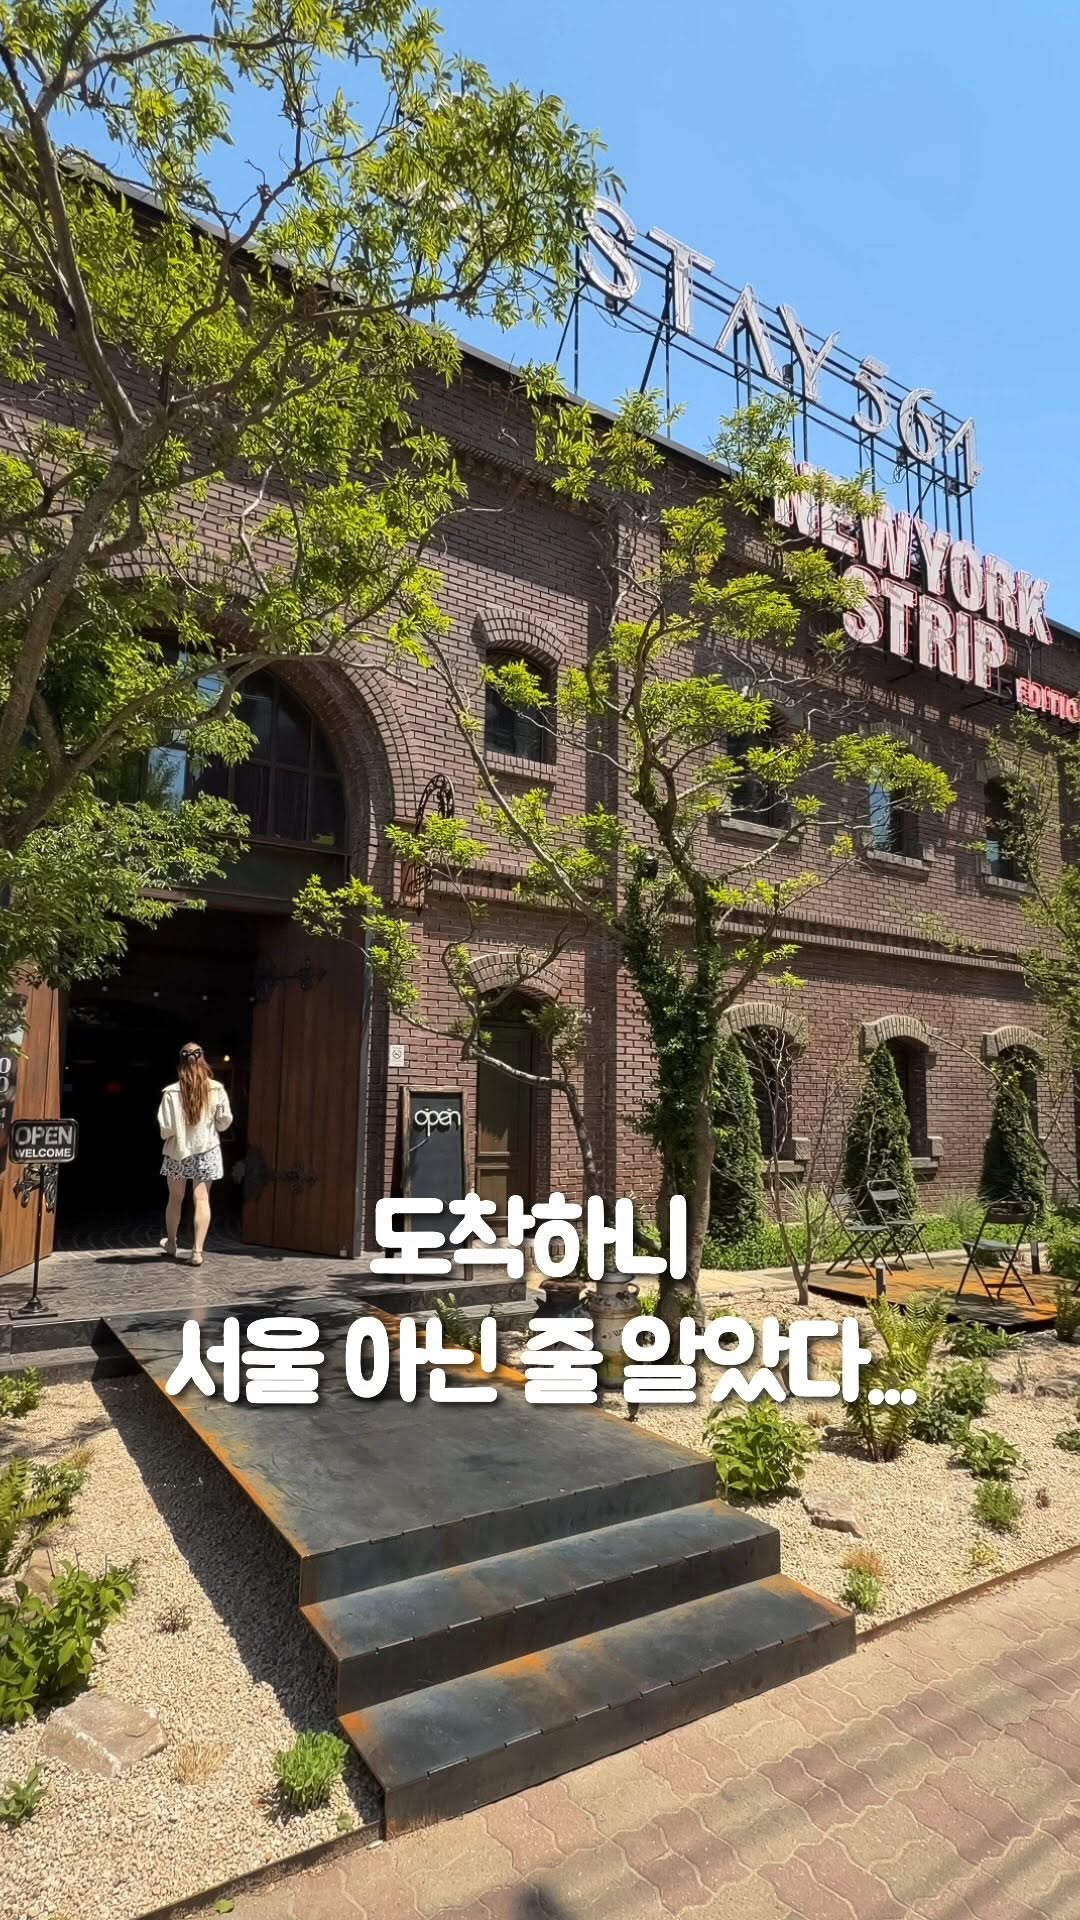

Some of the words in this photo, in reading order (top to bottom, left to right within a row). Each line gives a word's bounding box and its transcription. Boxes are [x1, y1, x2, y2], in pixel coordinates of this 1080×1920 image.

[580, 196, 841, 402] STAY
[853, 355, 983, 489] 561
[842, 563, 1008, 690] STRIP
[15, 1126, 73, 1146] OPEN
[414, 1108, 461, 1137] open
[15, 1148, 72, 1158] WELCOME
